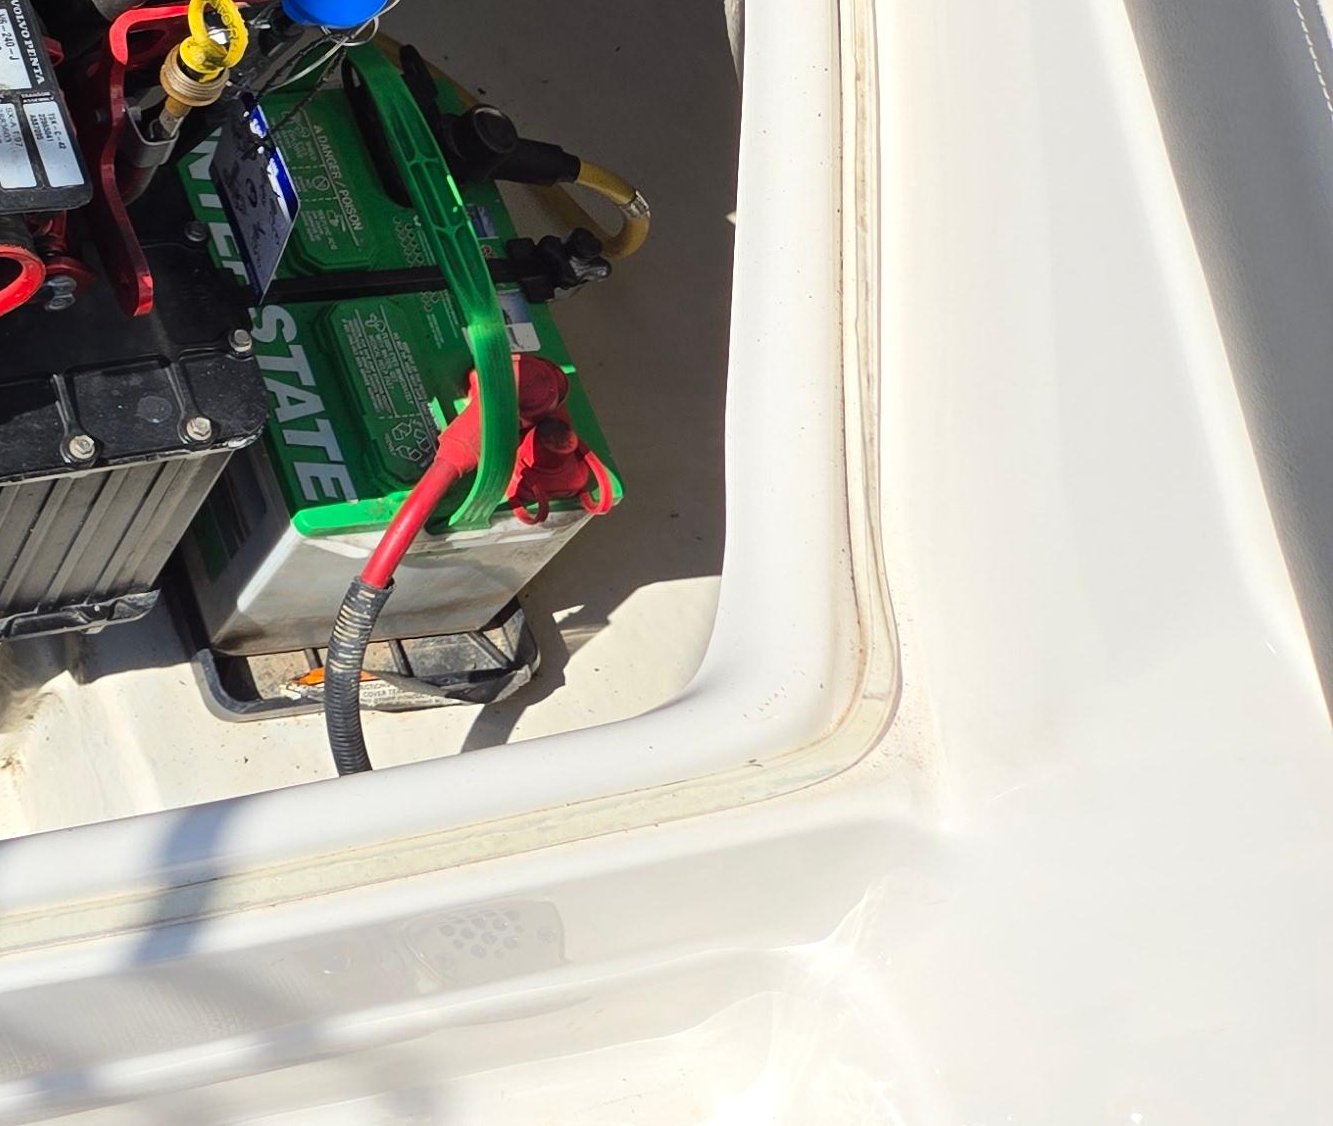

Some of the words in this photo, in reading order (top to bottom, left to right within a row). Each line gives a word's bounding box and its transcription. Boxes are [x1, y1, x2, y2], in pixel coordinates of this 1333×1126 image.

[24, 39, 45, 84] PENTA
[317, 134, 342, 179] DANGER
[338, 188, 363, 230] POISON
